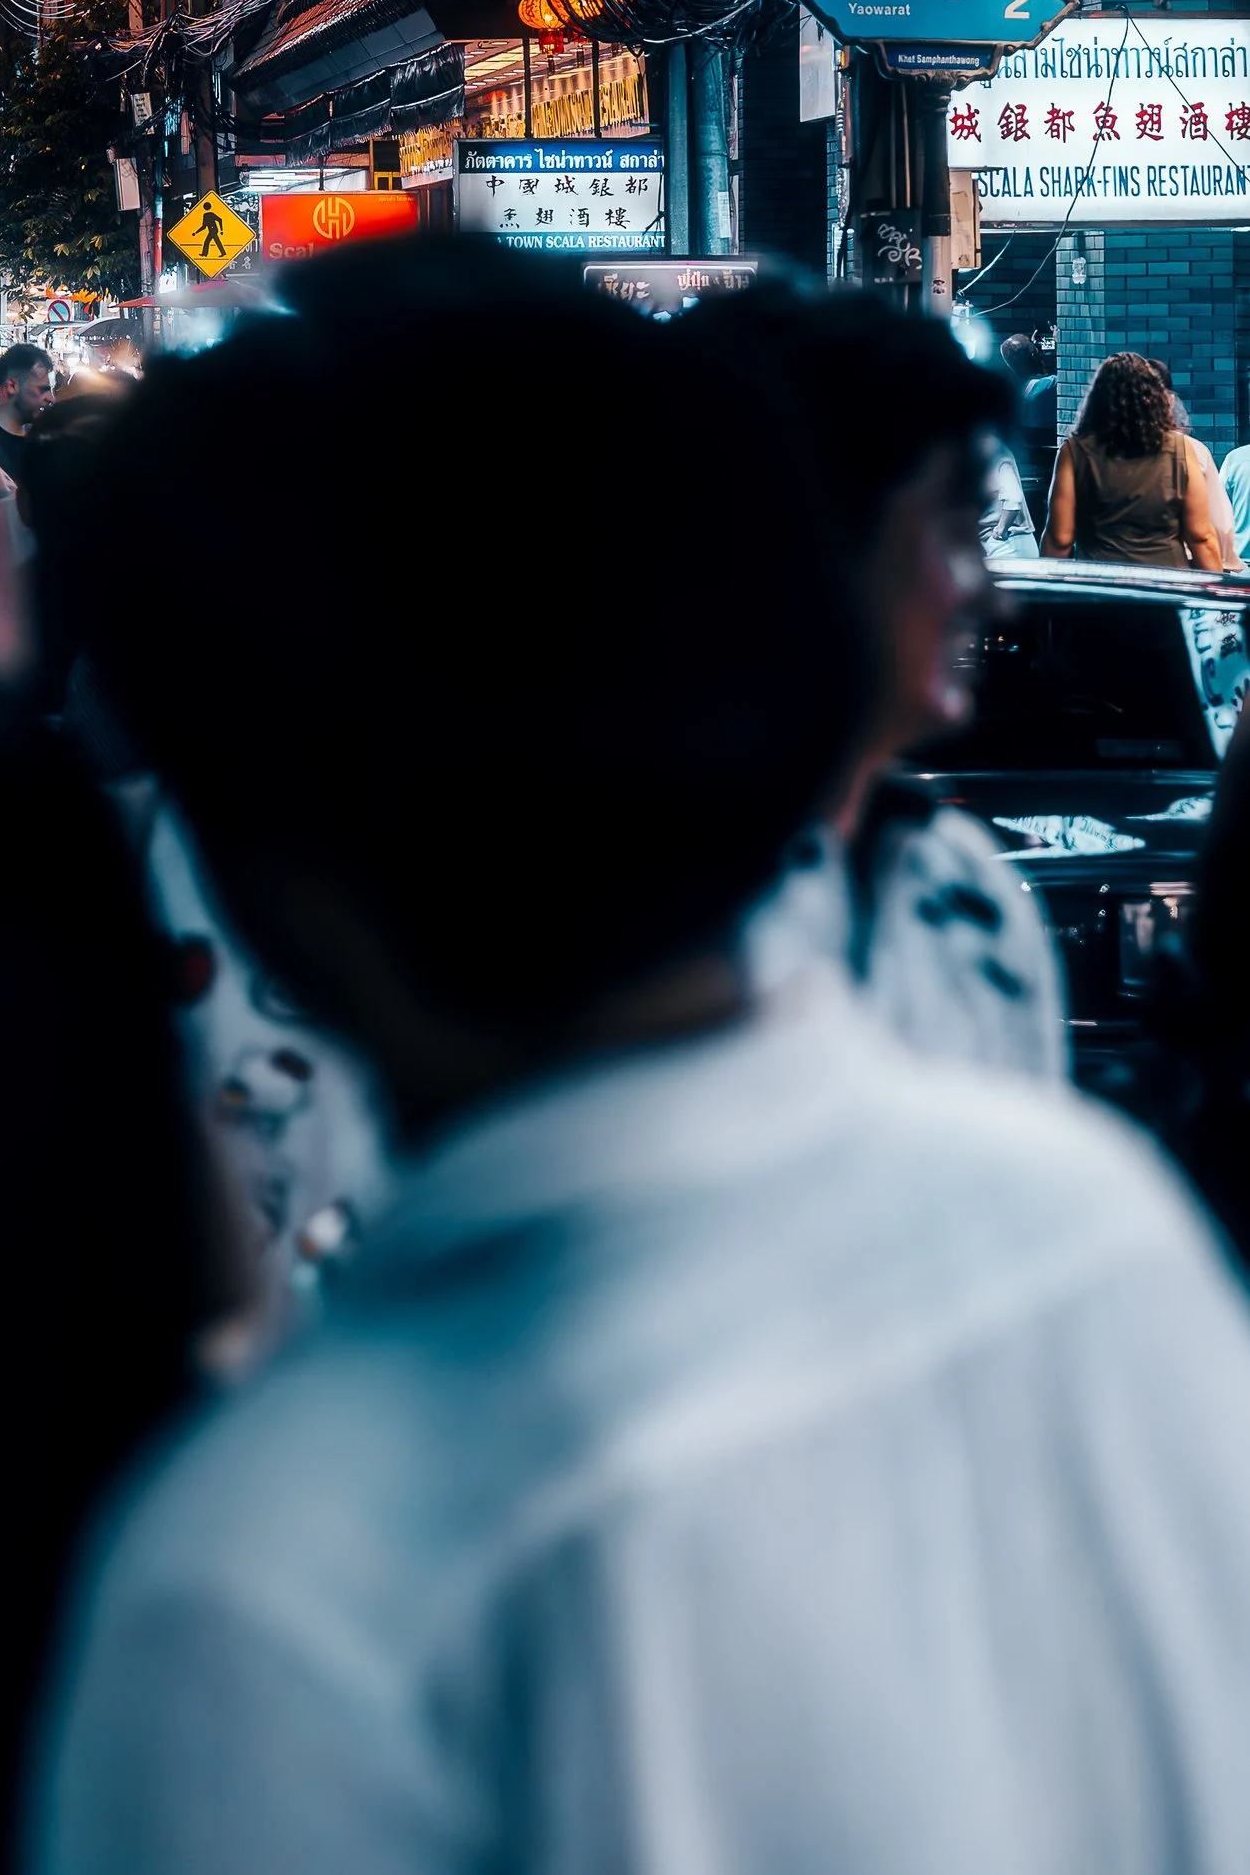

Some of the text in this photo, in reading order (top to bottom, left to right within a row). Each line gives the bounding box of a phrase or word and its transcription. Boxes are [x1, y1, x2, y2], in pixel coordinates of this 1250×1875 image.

[848, 2, 912, 18] Yaowarat
[915, 53, 981, 68] Samphanthawong
[464, 148, 664, 170] ภัตตาคาร ไชน่าทาวน์ สกาล่า
[485, 175, 649, 198] 中國城銀都
[977, 164, 1035, 199] SCALA
[1039, 164, 1141, 199] SHARK-FINS
[499, 206, 632, 230] 魚翅酒樓
[505, 235, 665, 249] TOWN SCALA RESTAURANT
